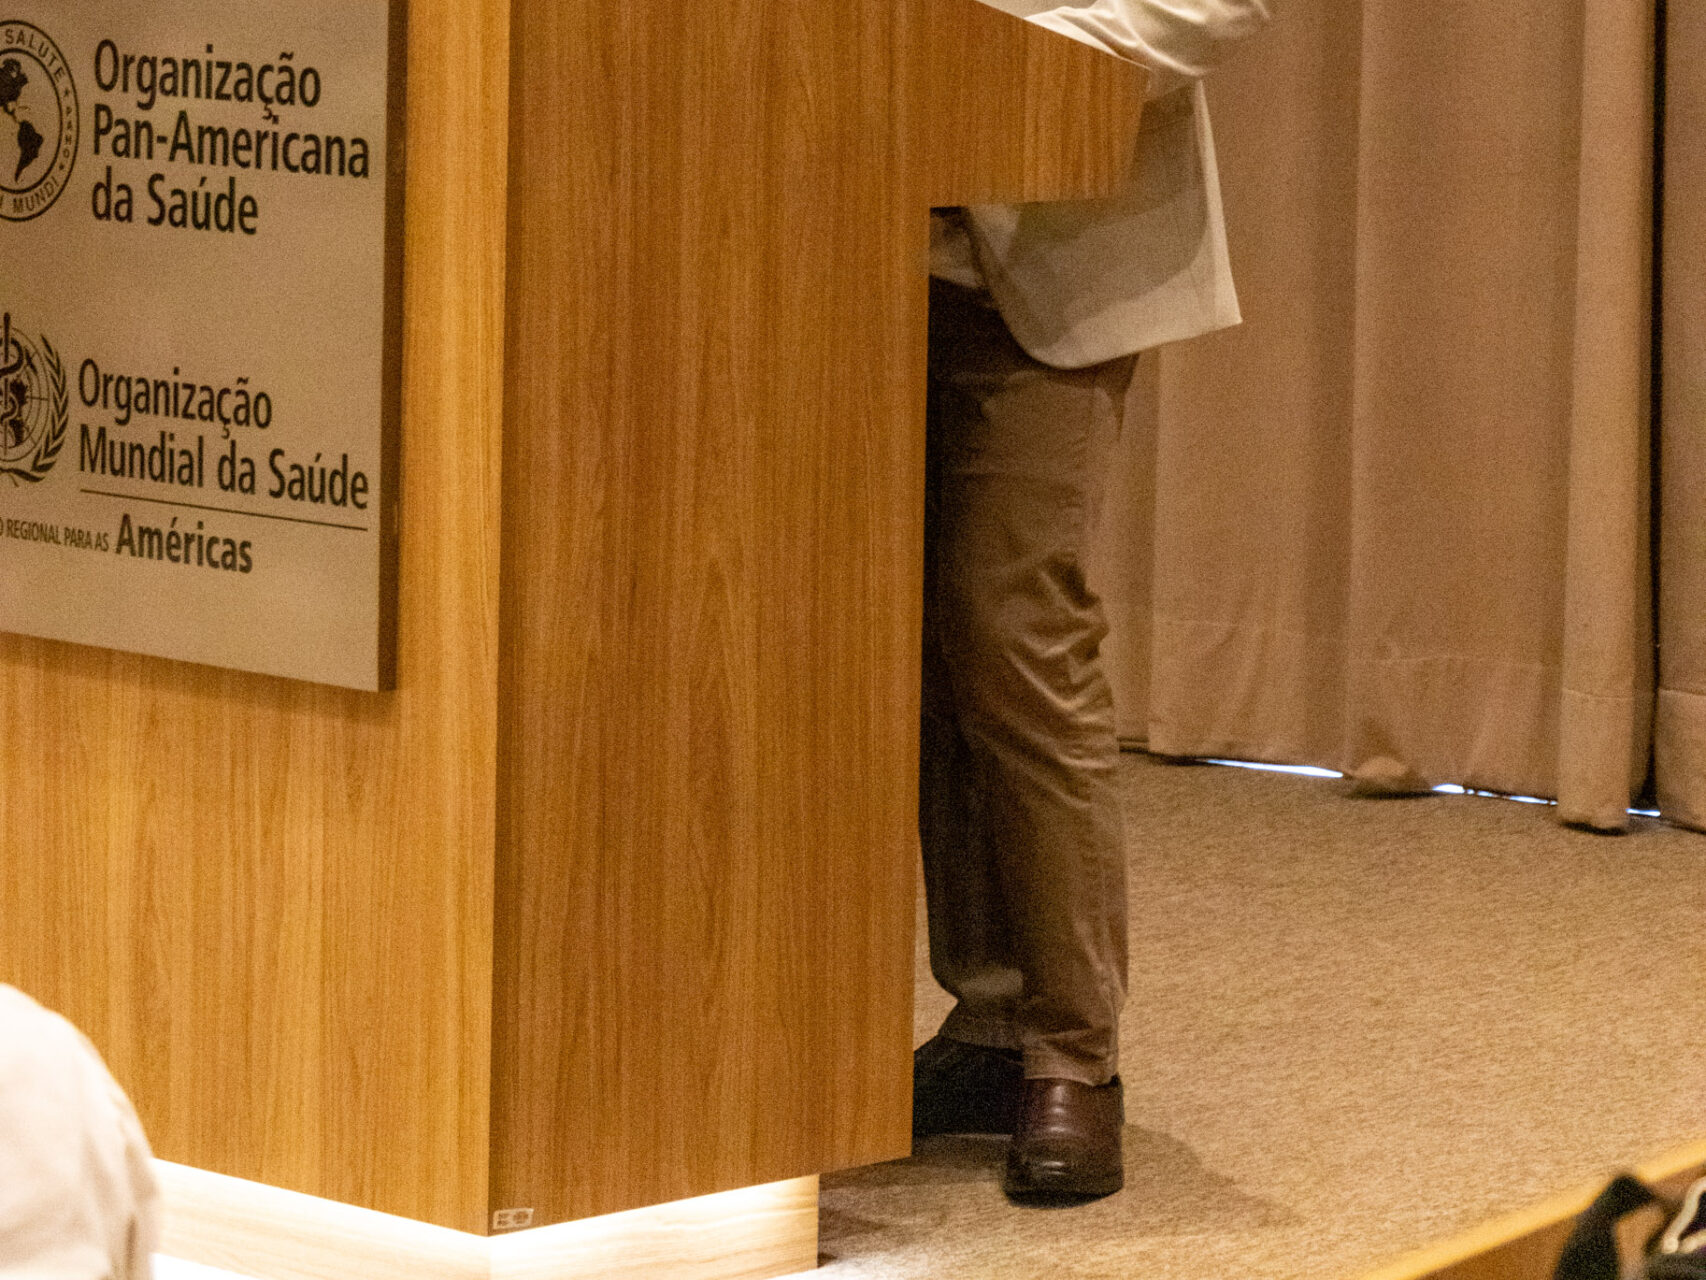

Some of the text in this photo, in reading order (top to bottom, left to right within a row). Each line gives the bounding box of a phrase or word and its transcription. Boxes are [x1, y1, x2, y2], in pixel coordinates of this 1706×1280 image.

[4, 28, 67, 84] SALUTE
[93, 38, 322, 124] Organização
[93, 103, 370, 179] Pan-Americana
[12, 175, 59, 214] MUNDI
[91, 165, 259, 236] da Saúde
[77, 357, 273, 440] Organização
[78, 422, 369, 511] Mundial da Saúde
[6, 518, 61, 545] REGIONAL
[63, 526, 93, 550] PARA
[94, 531, 109, 552] AS
[115, 512, 253, 574] Américas
